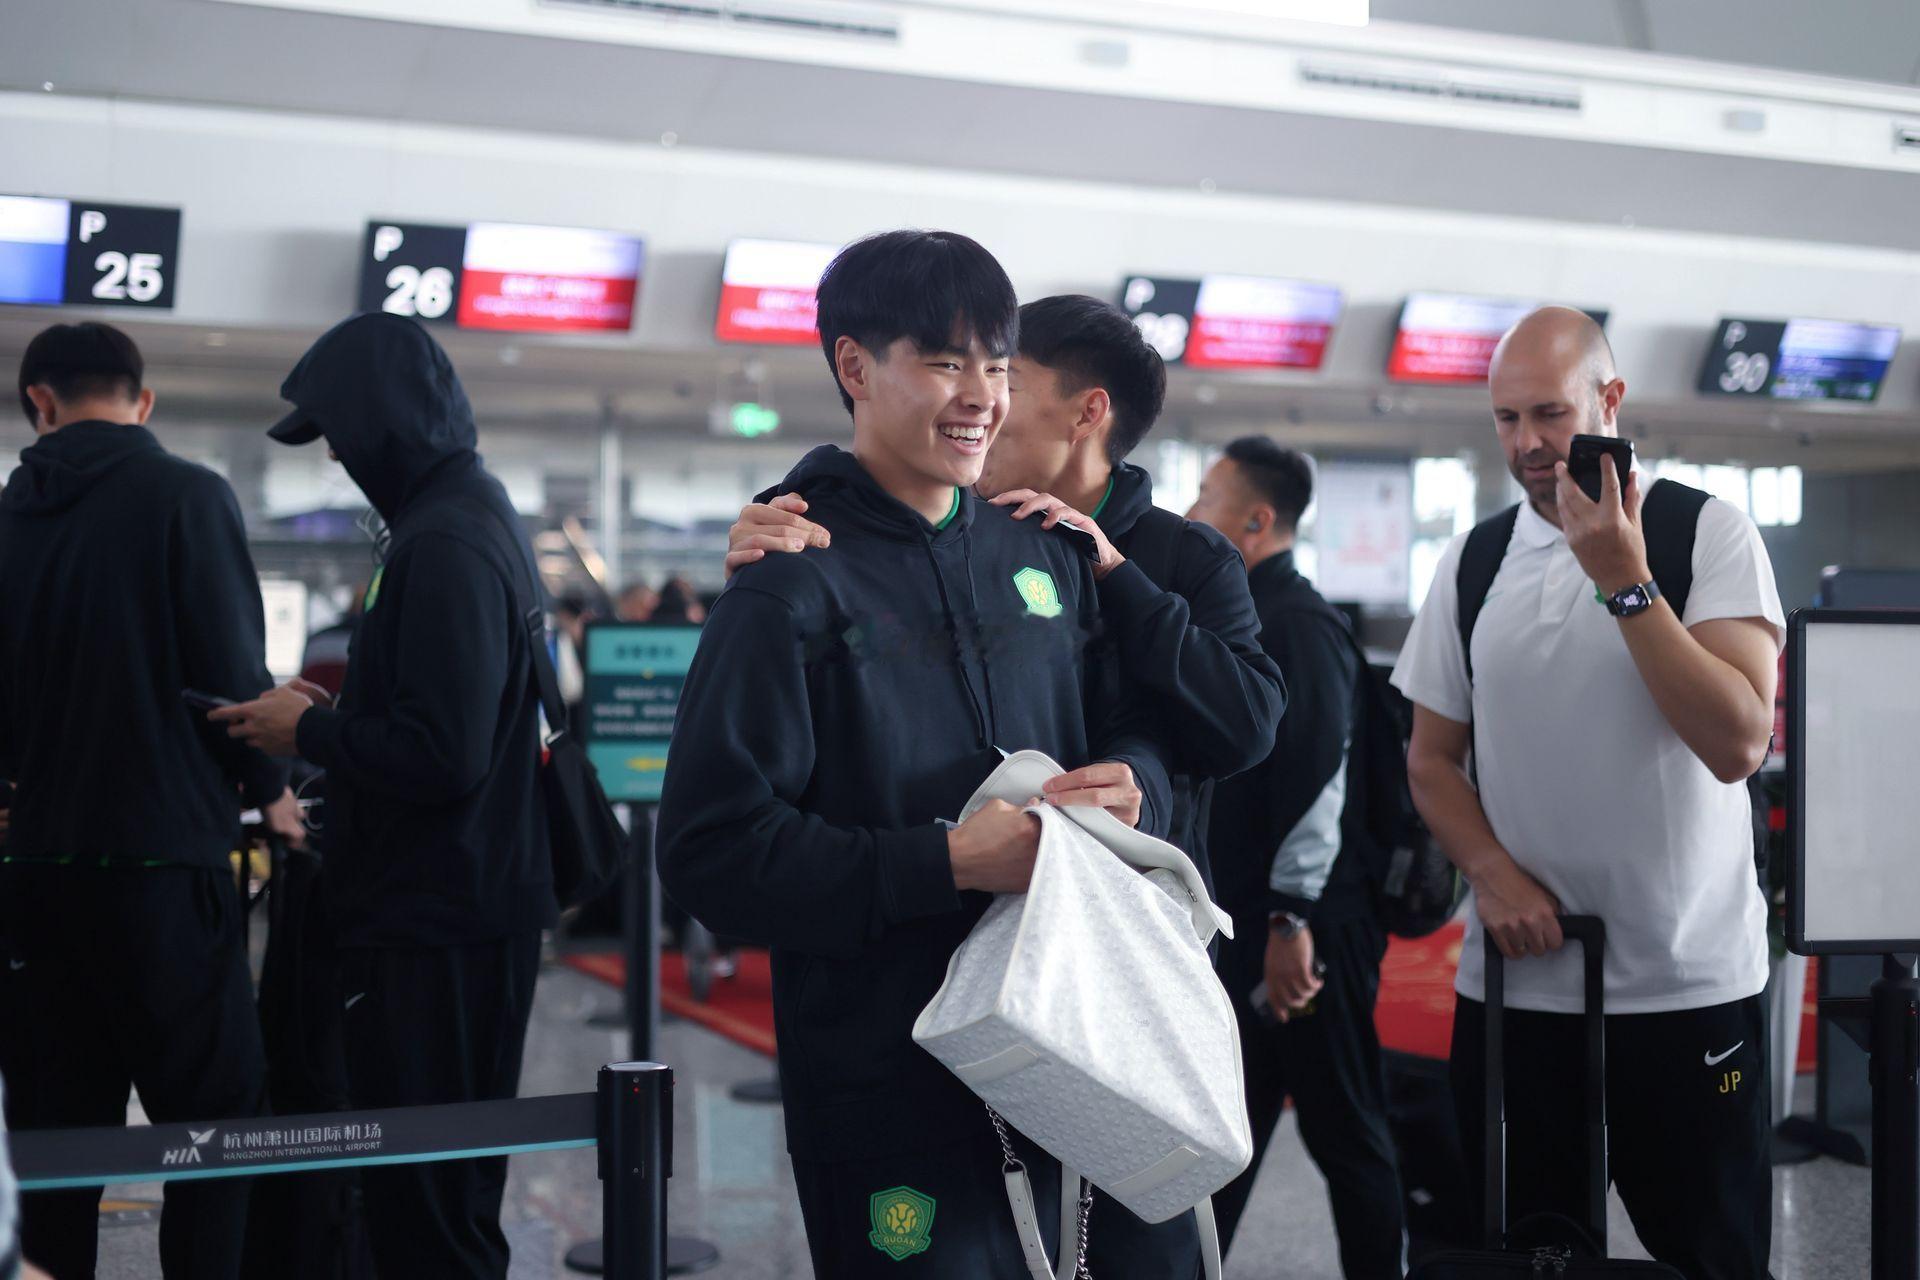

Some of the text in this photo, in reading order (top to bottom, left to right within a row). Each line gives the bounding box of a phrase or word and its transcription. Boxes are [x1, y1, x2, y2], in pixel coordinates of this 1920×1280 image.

[79, 210, 107, 243] P
[373, 225, 404, 262] P
[91, 250, 164, 302] 25
[381, 264, 454, 318] 26
[1719, 351, 1770, 393] 30
[1719, 1070, 1741, 1093] JP
[223, 1122, 382, 1149] 杭州萧山国际机场
[223, 1141, 382, 1160] HANGZHOU INTERNATIONAL AIRPORT
[884, 1236, 917, 1247] GUOAN
